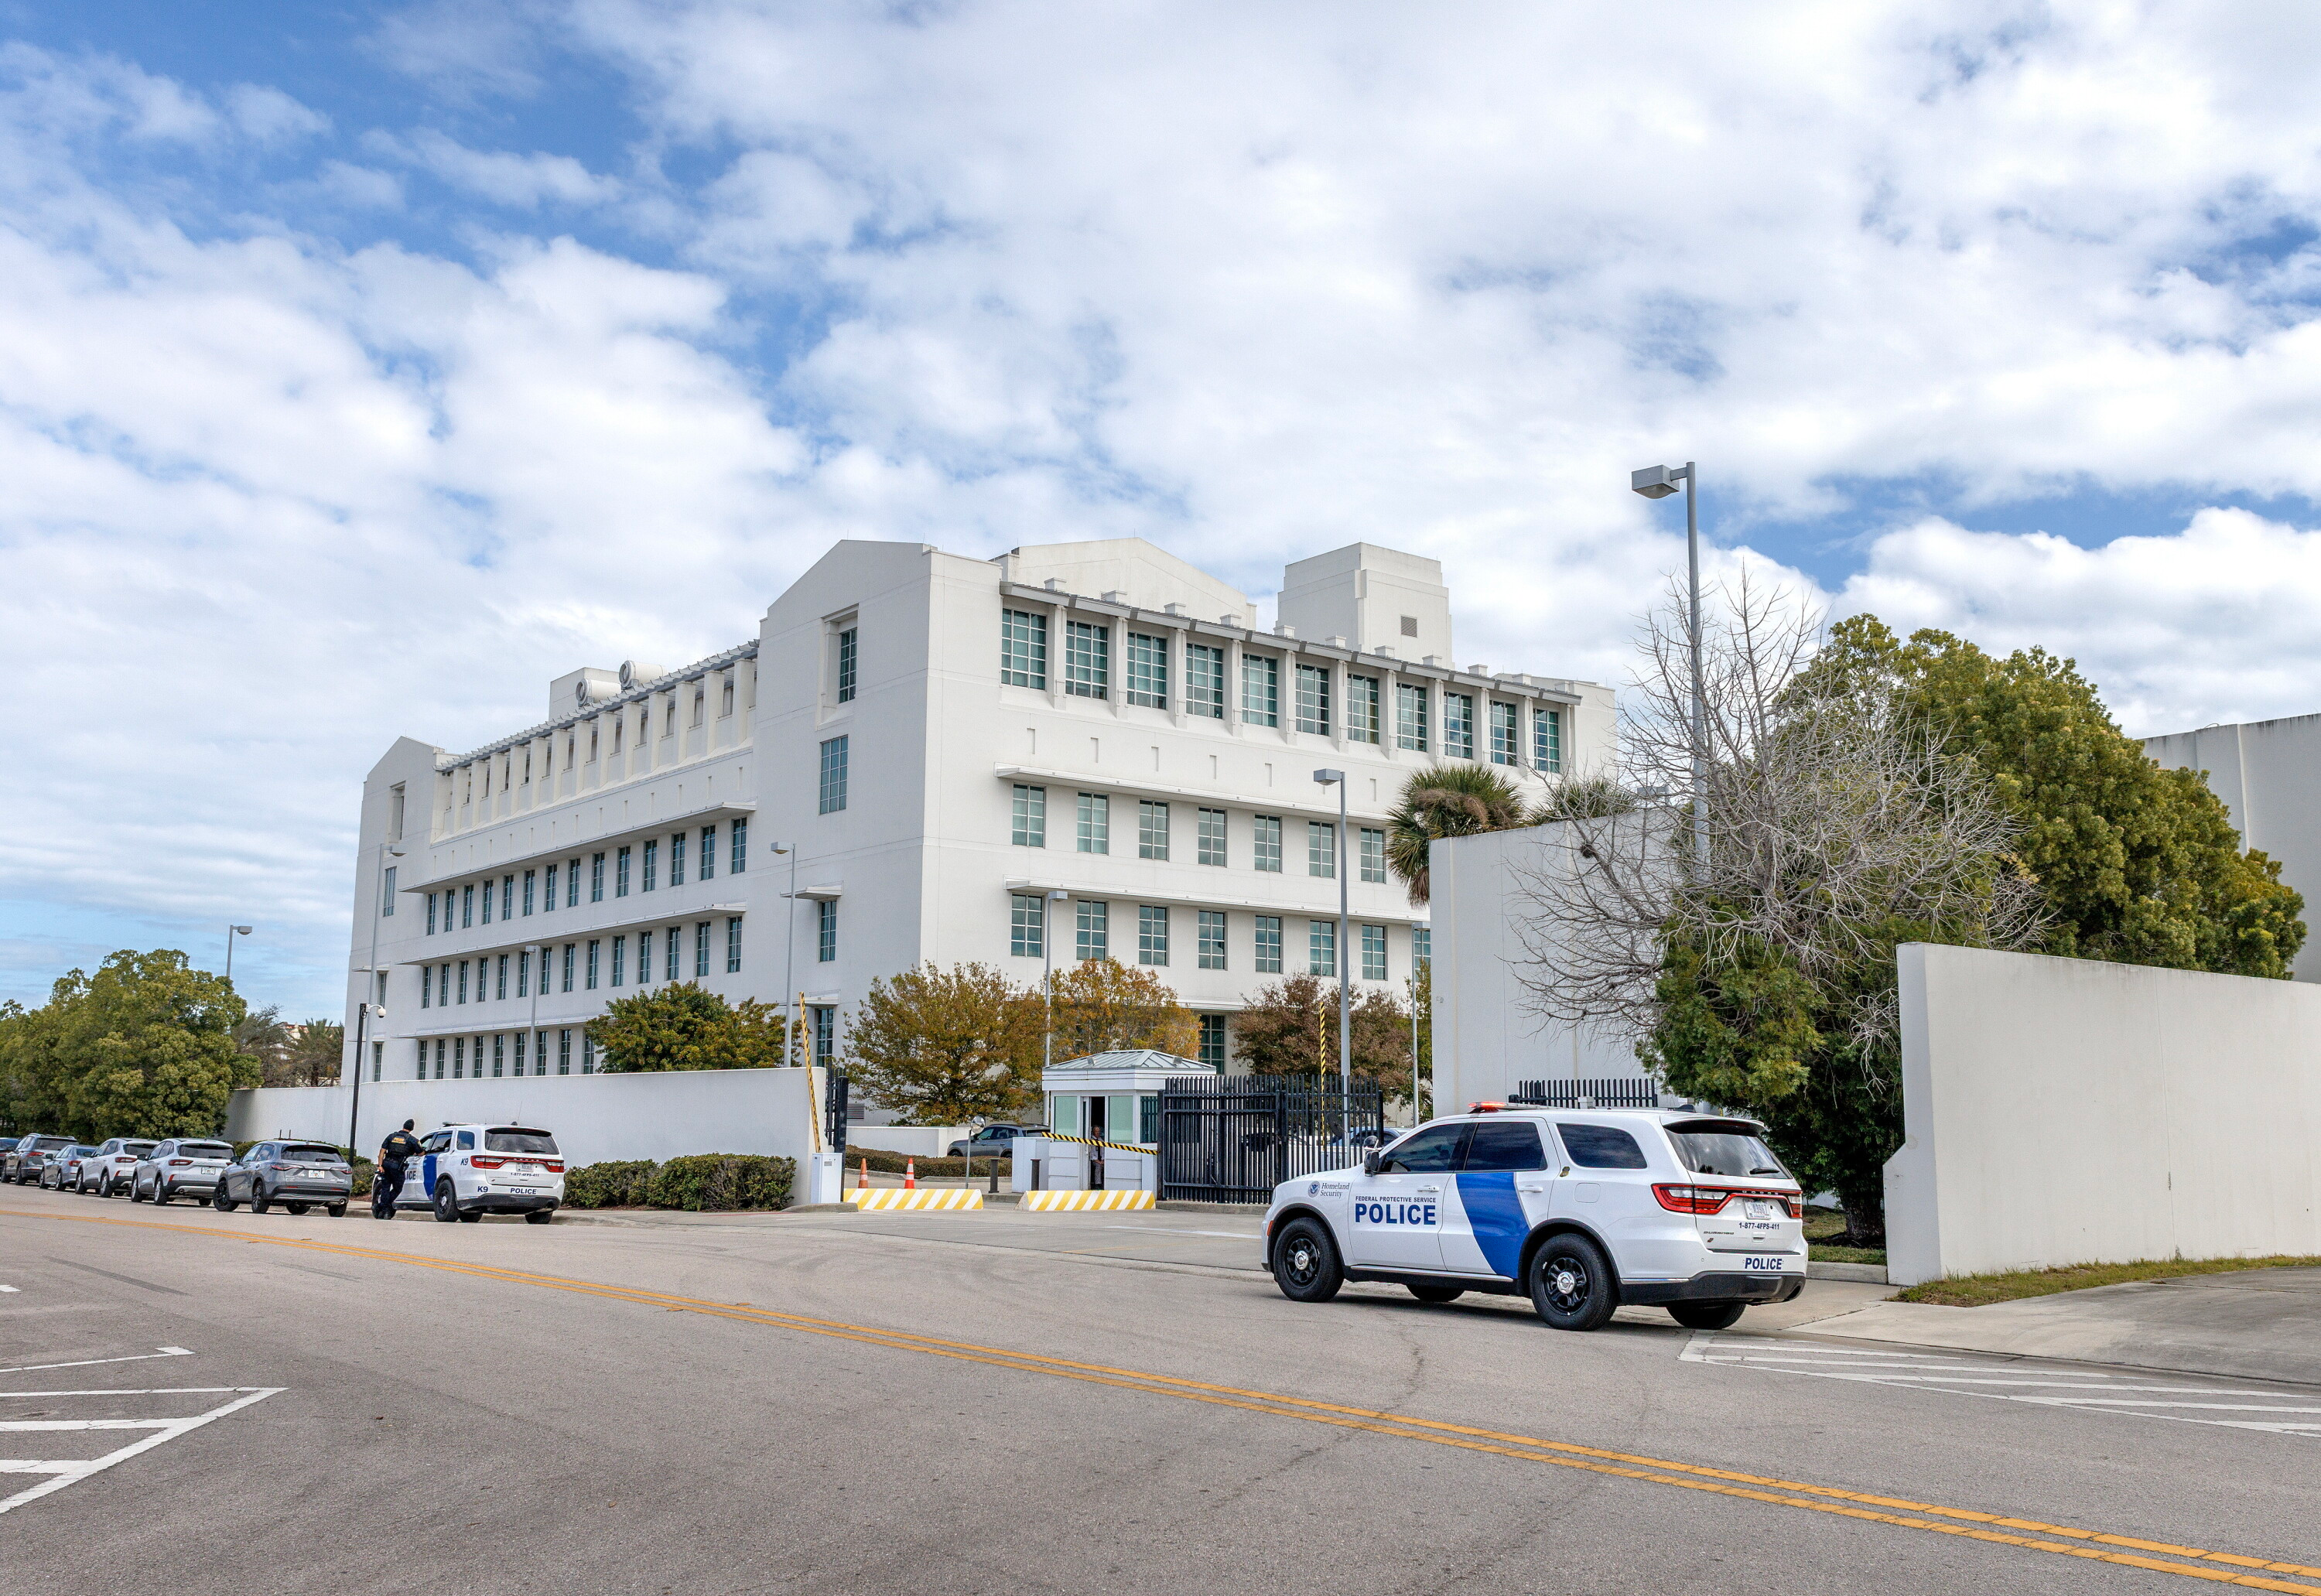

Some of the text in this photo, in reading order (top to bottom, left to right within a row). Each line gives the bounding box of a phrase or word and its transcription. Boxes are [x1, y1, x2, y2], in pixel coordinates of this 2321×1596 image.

[406, 1171, 416, 1181] ICE
[1320, 1190, 1342, 1198] Security
[1355, 1203, 1436, 1225] POLICE
[1745, 1257, 1783, 1270] POLICE
